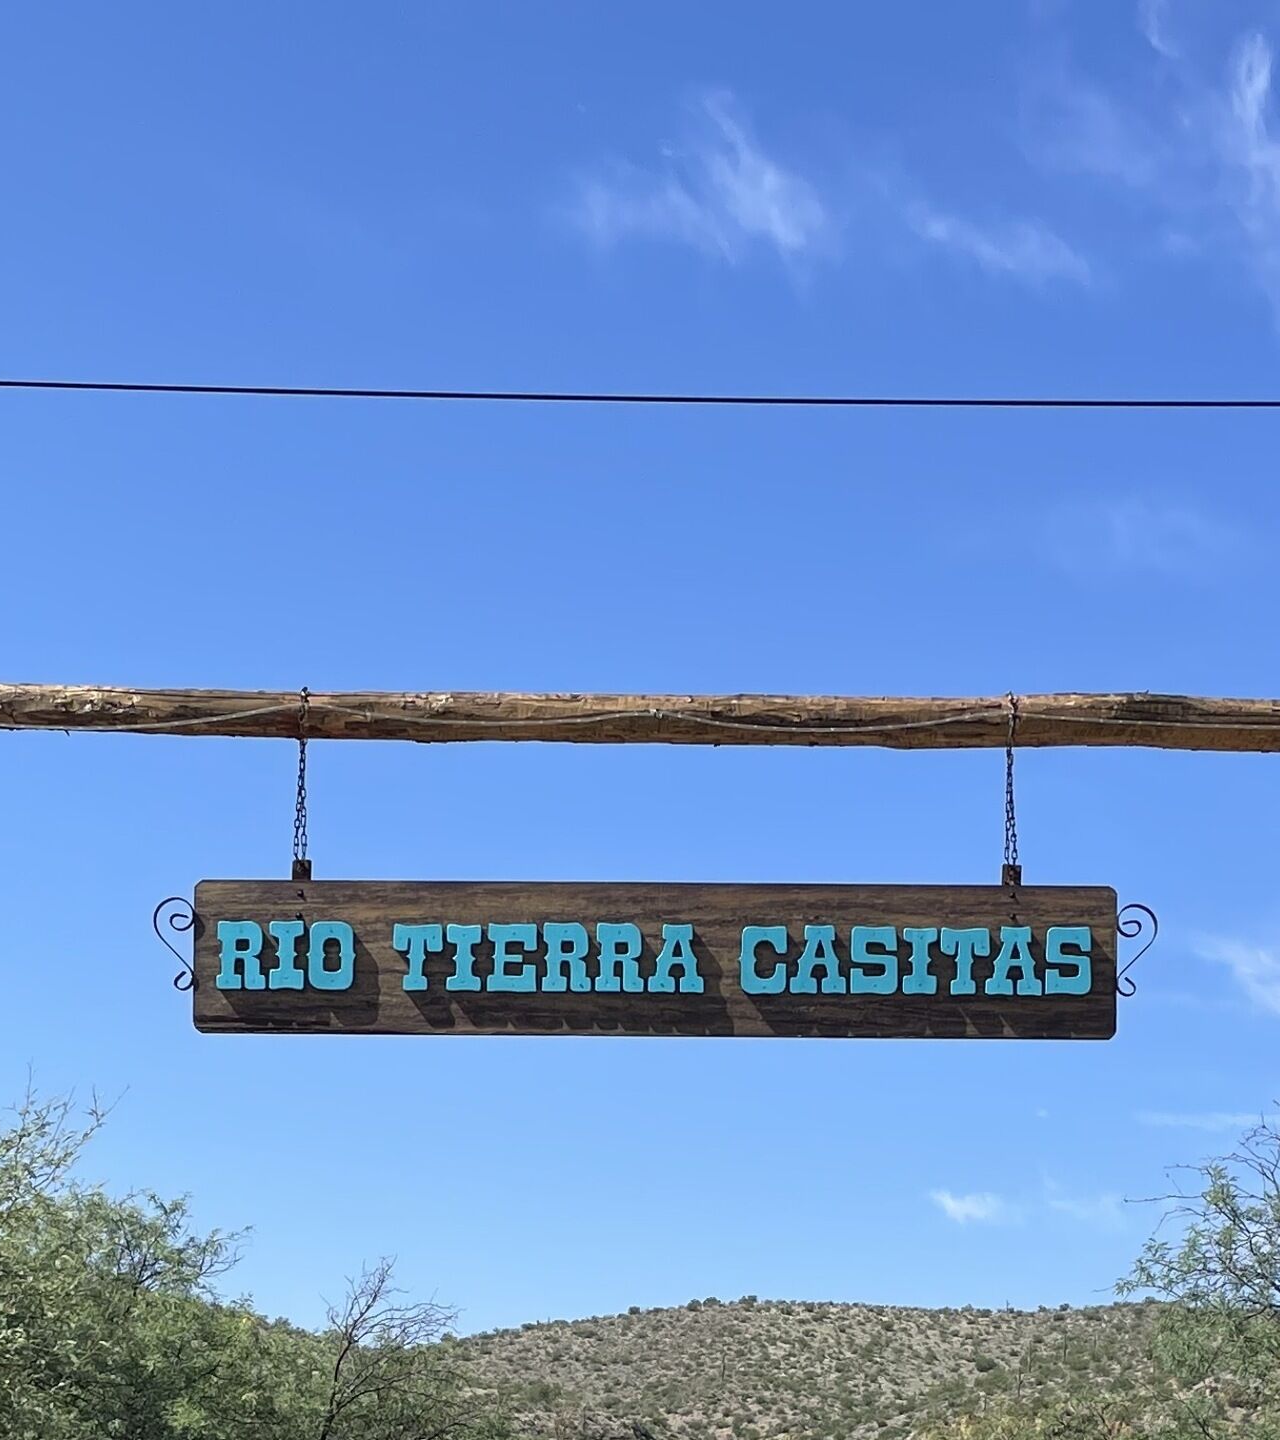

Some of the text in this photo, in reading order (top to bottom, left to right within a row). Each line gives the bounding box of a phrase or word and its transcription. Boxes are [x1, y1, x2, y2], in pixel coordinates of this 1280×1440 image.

[215, 919, 1093, 997] RIO TIERRA CASITAS
